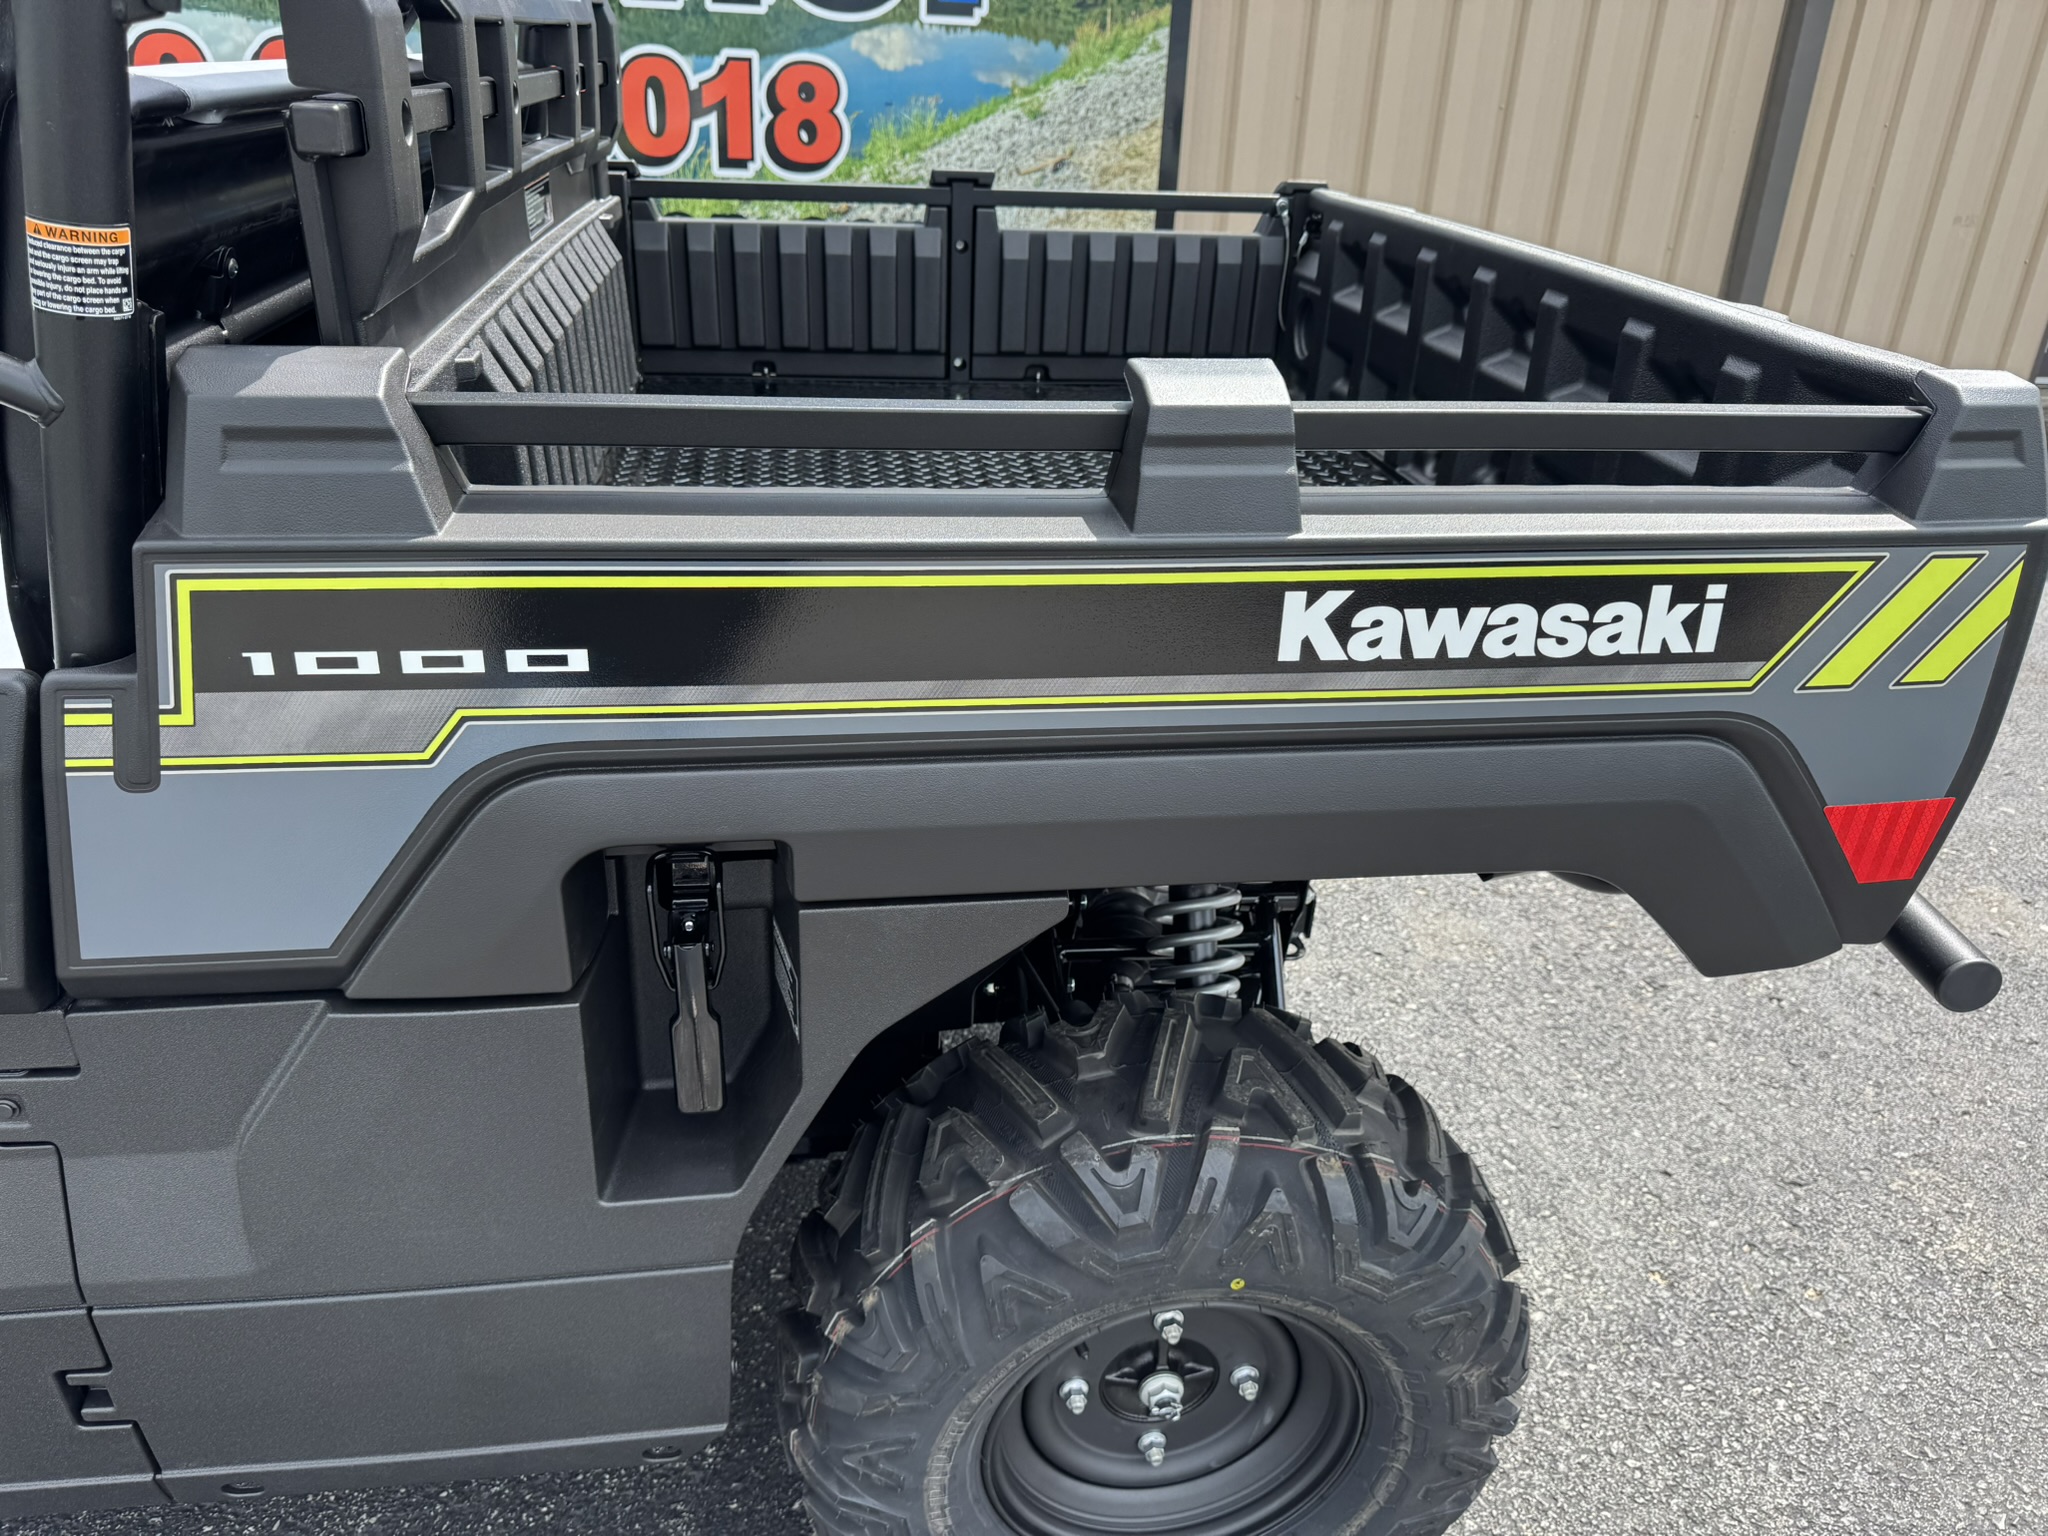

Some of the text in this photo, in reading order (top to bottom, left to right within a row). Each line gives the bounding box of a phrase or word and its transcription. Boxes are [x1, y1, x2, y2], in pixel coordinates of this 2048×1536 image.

[45, 225, 119, 243] WARNING
[43, 242, 72, 253] clearance
[73, 245, 100, 255] between
[112, 248, 126, 256] cargo
[42, 250, 51, 259] the
[52, 253, 69, 263] cargo
[71, 256, 93, 265] screen
[94, 258, 107, 267] may
[107, 258, 119, 267] trap
[34, 259, 56, 271] seriously
[57, 263, 76, 274] injure
[100, 267, 116, 275] while
[33, 268, 52, 281] lowering
[52, 272, 62, 281] the
[63, 275, 82, 285] cargo
[82, 276, 97, 285] bed.
[97, 277, 106, 285] To
[106, 276, 121, 285] avoid
[46, 291, 52, 299] of
[52, 292, 62, 300] the
[63, 294, 82, 304] cargo
[104, 296, 120, 304] when
[64, 284, 73, 292] do
[74, 286, 86, 294] not
[86, 286, 104, 295] place
[104, 286, 121, 294] hands
[47, 300, 72, 313] lowering
[73, 304, 84, 313] the
[85, 306, 104, 315] cargo
[104, 306, 117, 314] bed.
[1277, 583, 1728, 662] Kawasaki
[241, 648, 590, 676] 1000
